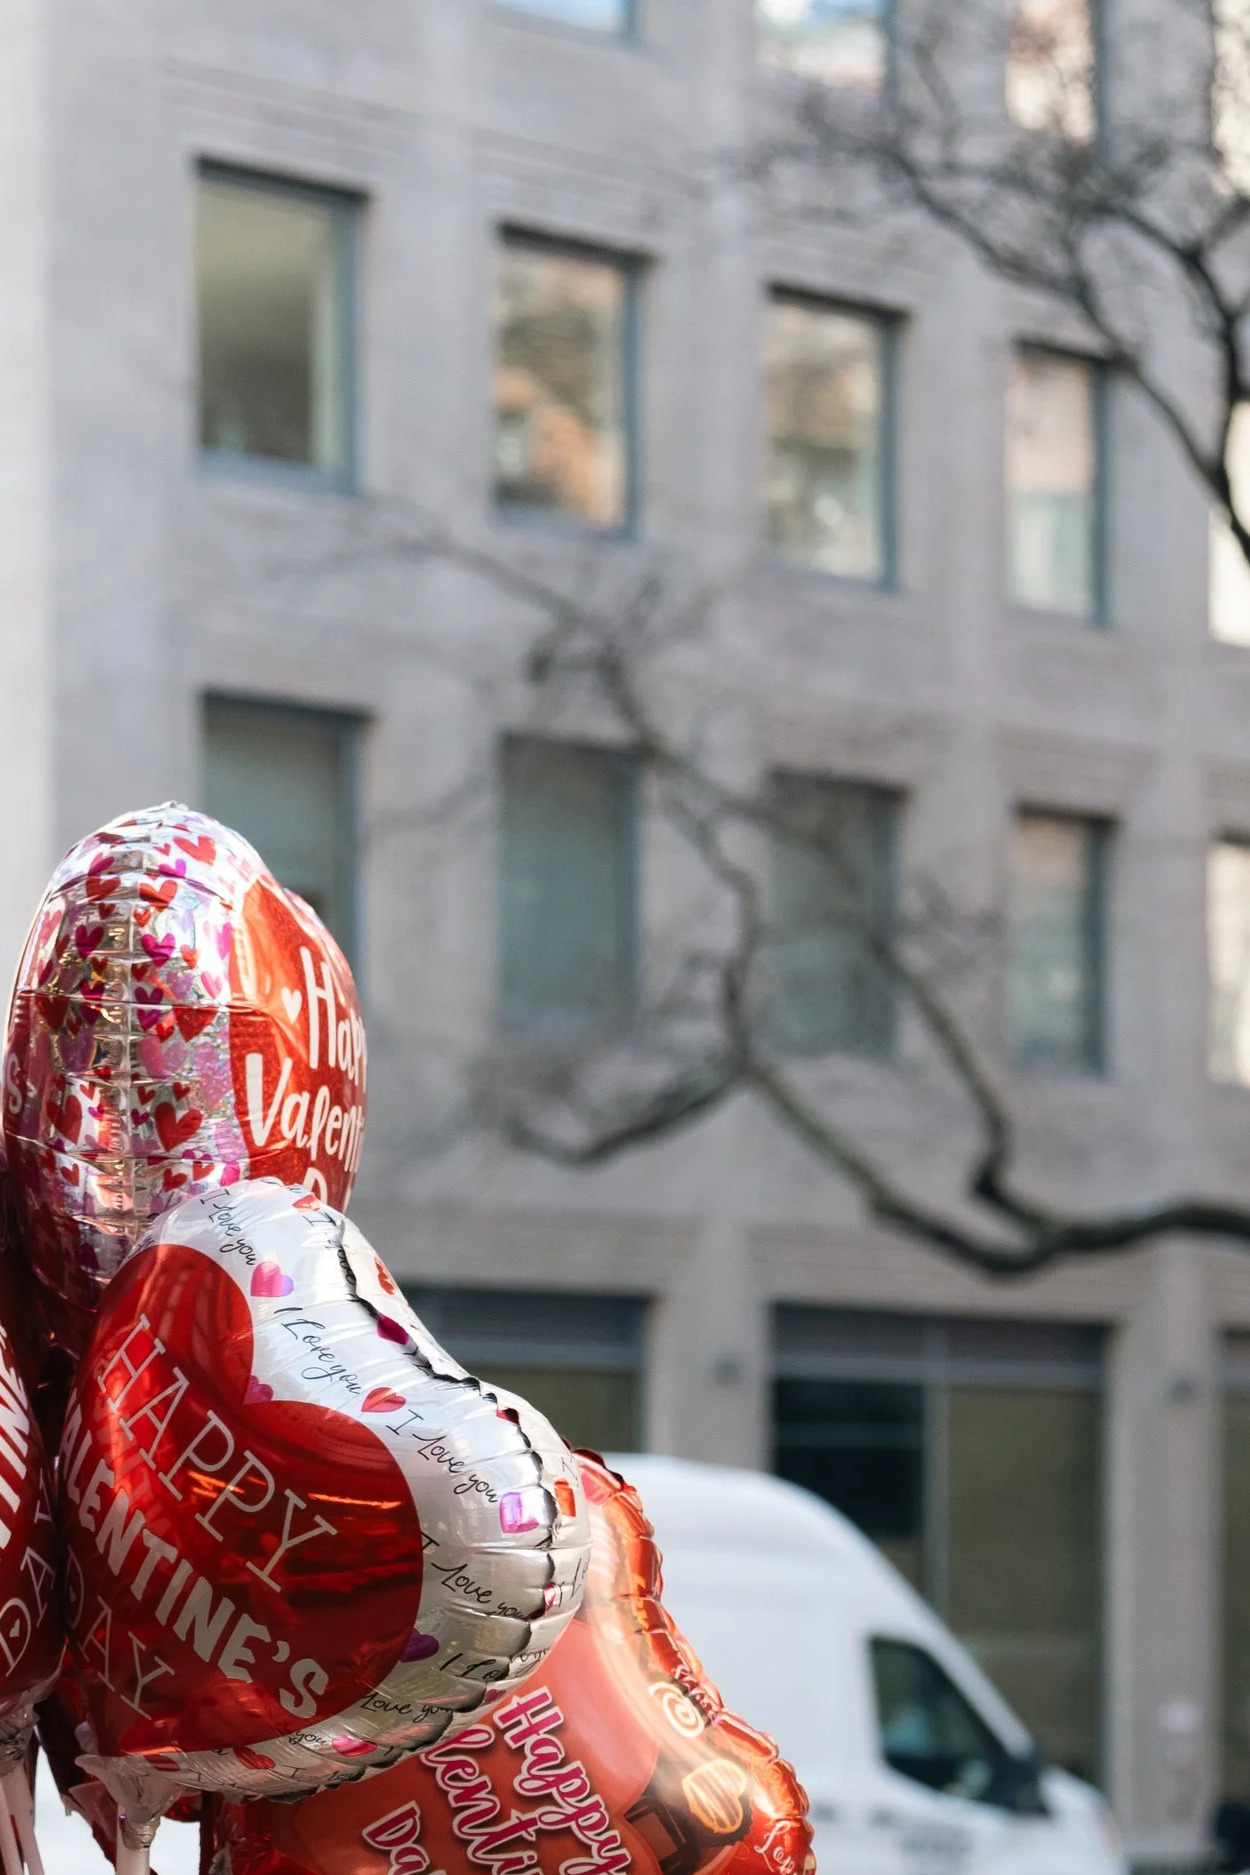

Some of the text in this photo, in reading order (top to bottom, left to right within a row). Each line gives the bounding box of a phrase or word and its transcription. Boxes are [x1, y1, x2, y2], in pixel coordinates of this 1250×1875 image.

[300, 946, 367, 1092] Hap
[246, 1053, 365, 1173] Valent
[209, 1201, 242, 1238] Love
[219, 1237, 258, 1267] you
[301, 1364, 362, 1395] you
[97, 1313, 338, 1592] HAPPY
[386, 1409, 498, 1504] I Love you
[60, 1387, 329, 1719] ALENTINE'S
[431, 1563, 492, 1604] Love
